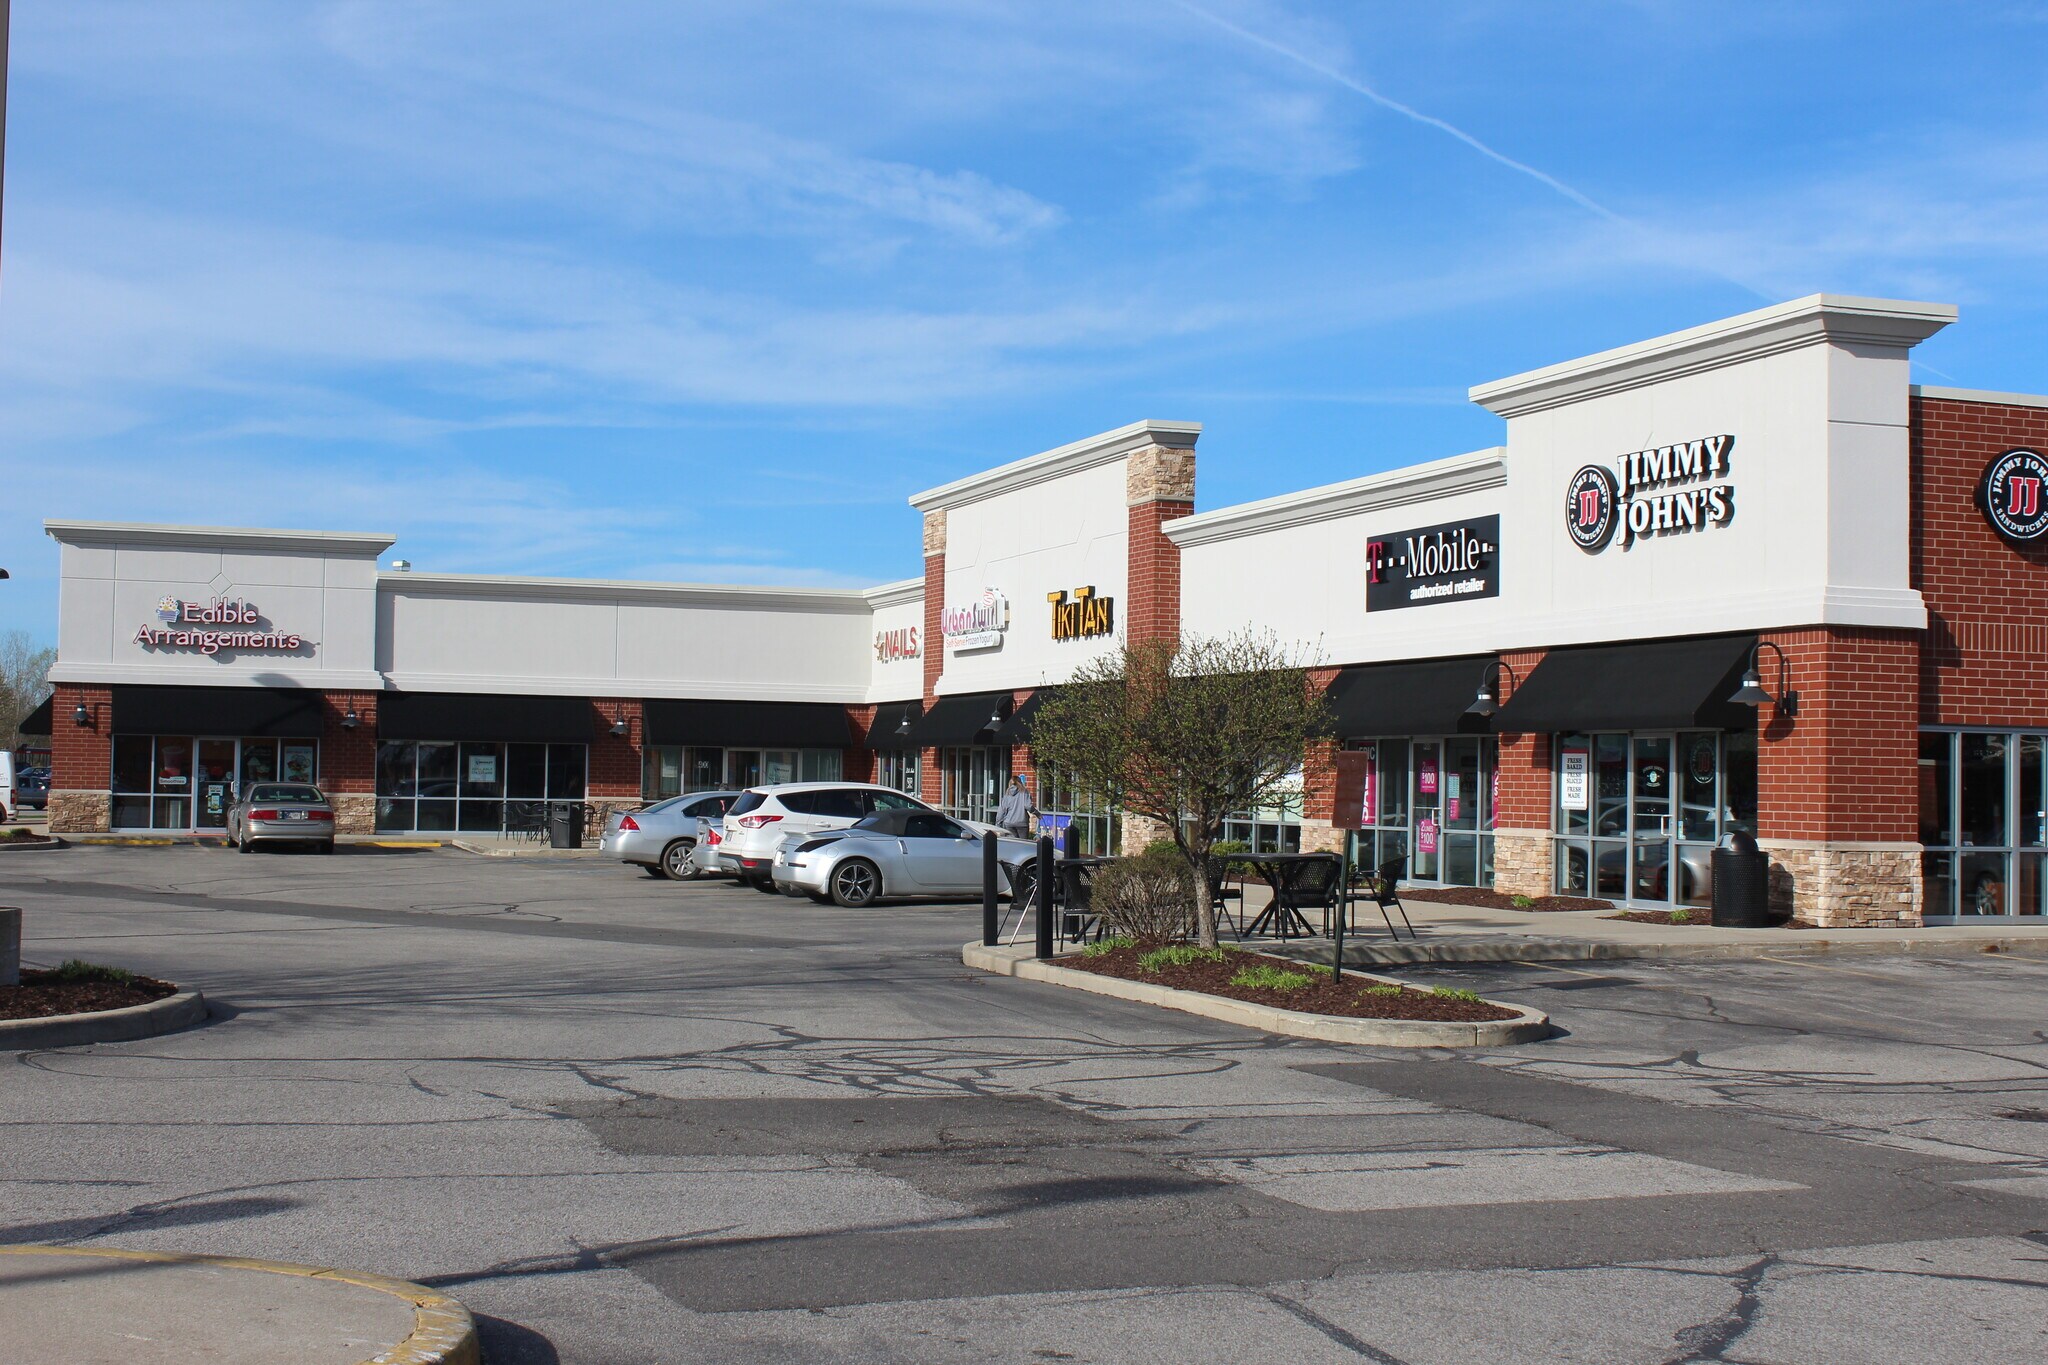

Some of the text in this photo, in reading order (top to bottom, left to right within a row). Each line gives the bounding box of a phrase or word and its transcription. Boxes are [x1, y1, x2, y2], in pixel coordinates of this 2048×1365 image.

[1617, 435, 1727, 498] JIMMY
[1993, 457, 2048, 496] JIMMY JOHN
[1570, 473, 1588, 510] JIMMY
[1579, 488, 1599, 526] JJ
[2007, 475, 2040, 516] JJ
[1616, 485, 1727, 546] JOHN'S
[1996, 507, 2048, 533] SANDWICHES
[1410, 578, 1486, 600] authorized retailer
[183, 597, 257, 624] Edible
[1047, 586, 1109, 640] TIKI TAN
[133, 624, 301, 655] Arrangements
[885, 626, 918, 659] NAILS
[1421, 772, 1435, 784] $100
[1420, 832, 1434, 844] $100
